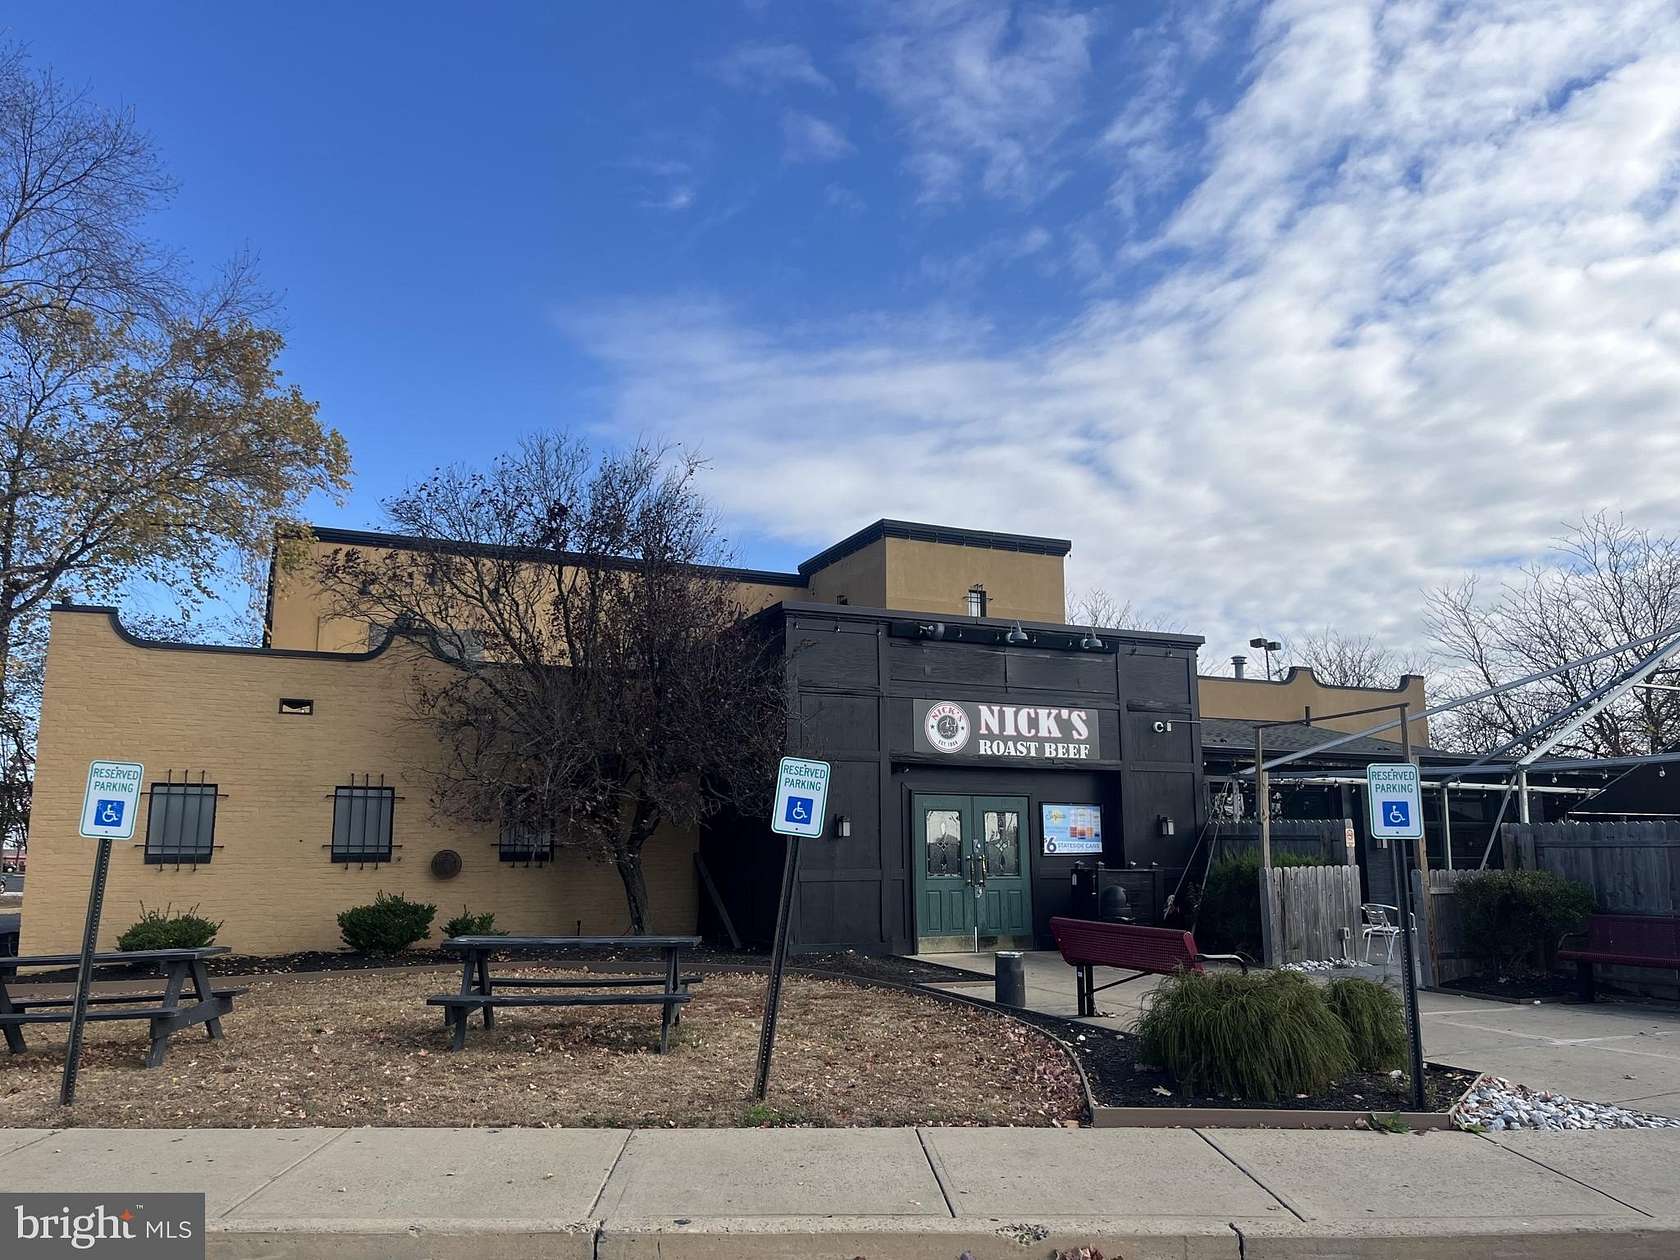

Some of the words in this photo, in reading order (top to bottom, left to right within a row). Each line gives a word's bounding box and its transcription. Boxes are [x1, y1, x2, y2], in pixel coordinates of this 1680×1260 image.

[931, 707, 963, 722] NICK'S
[978, 705, 1089, 740] NICK'S
[978, 739, 1039, 757] ROAST
[1043, 742, 1090, 759] BEEF
[93, 768, 139, 780] RESERVED
[783, 764, 826, 779] RESERVED
[1371, 771, 1415, 781] RESERVED
[94, 781, 134, 793] PARKING
[784, 778, 821, 792] PARKING
[1375, 783, 1413, 793] PARKING
